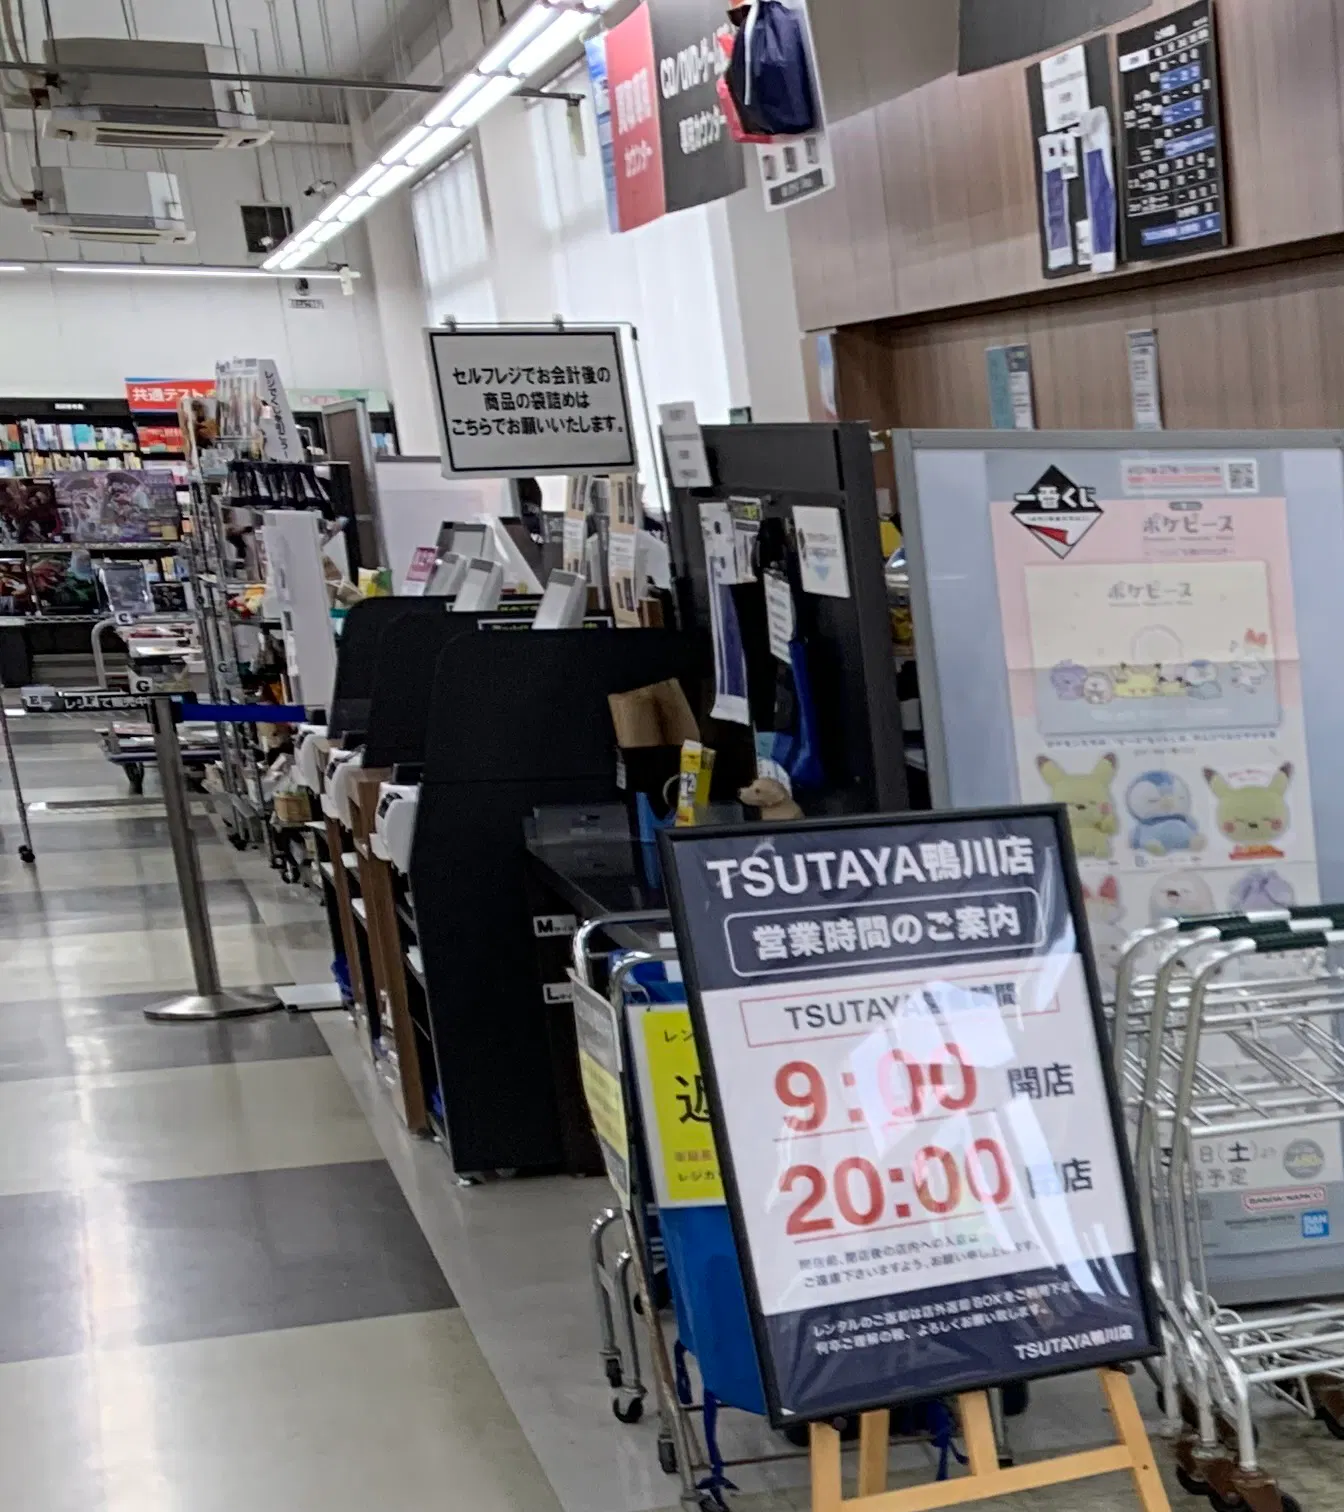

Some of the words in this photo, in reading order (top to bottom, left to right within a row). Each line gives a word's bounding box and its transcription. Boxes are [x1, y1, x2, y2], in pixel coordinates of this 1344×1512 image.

[452, 365, 611, 386] セルフレジでお会計後の
[482, 391, 591, 411] 商品の袋詰めは
[452, 415, 624, 436] こちらでお願いいたします。
[1013, 485, 1097, 509] 一番くじ
[706, 836, 1035, 899] TSUTAYA鴨川店
[752, 902, 1021, 961] 営業時間のご案内
[1007, 1061, 1077, 1100] 開店
[779, 1136, 1012, 1236] 20:00
[1025, 1157, 1094, 1200] 店
[1014, 1324, 1134, 1360] TSUTAYA鴨川店
